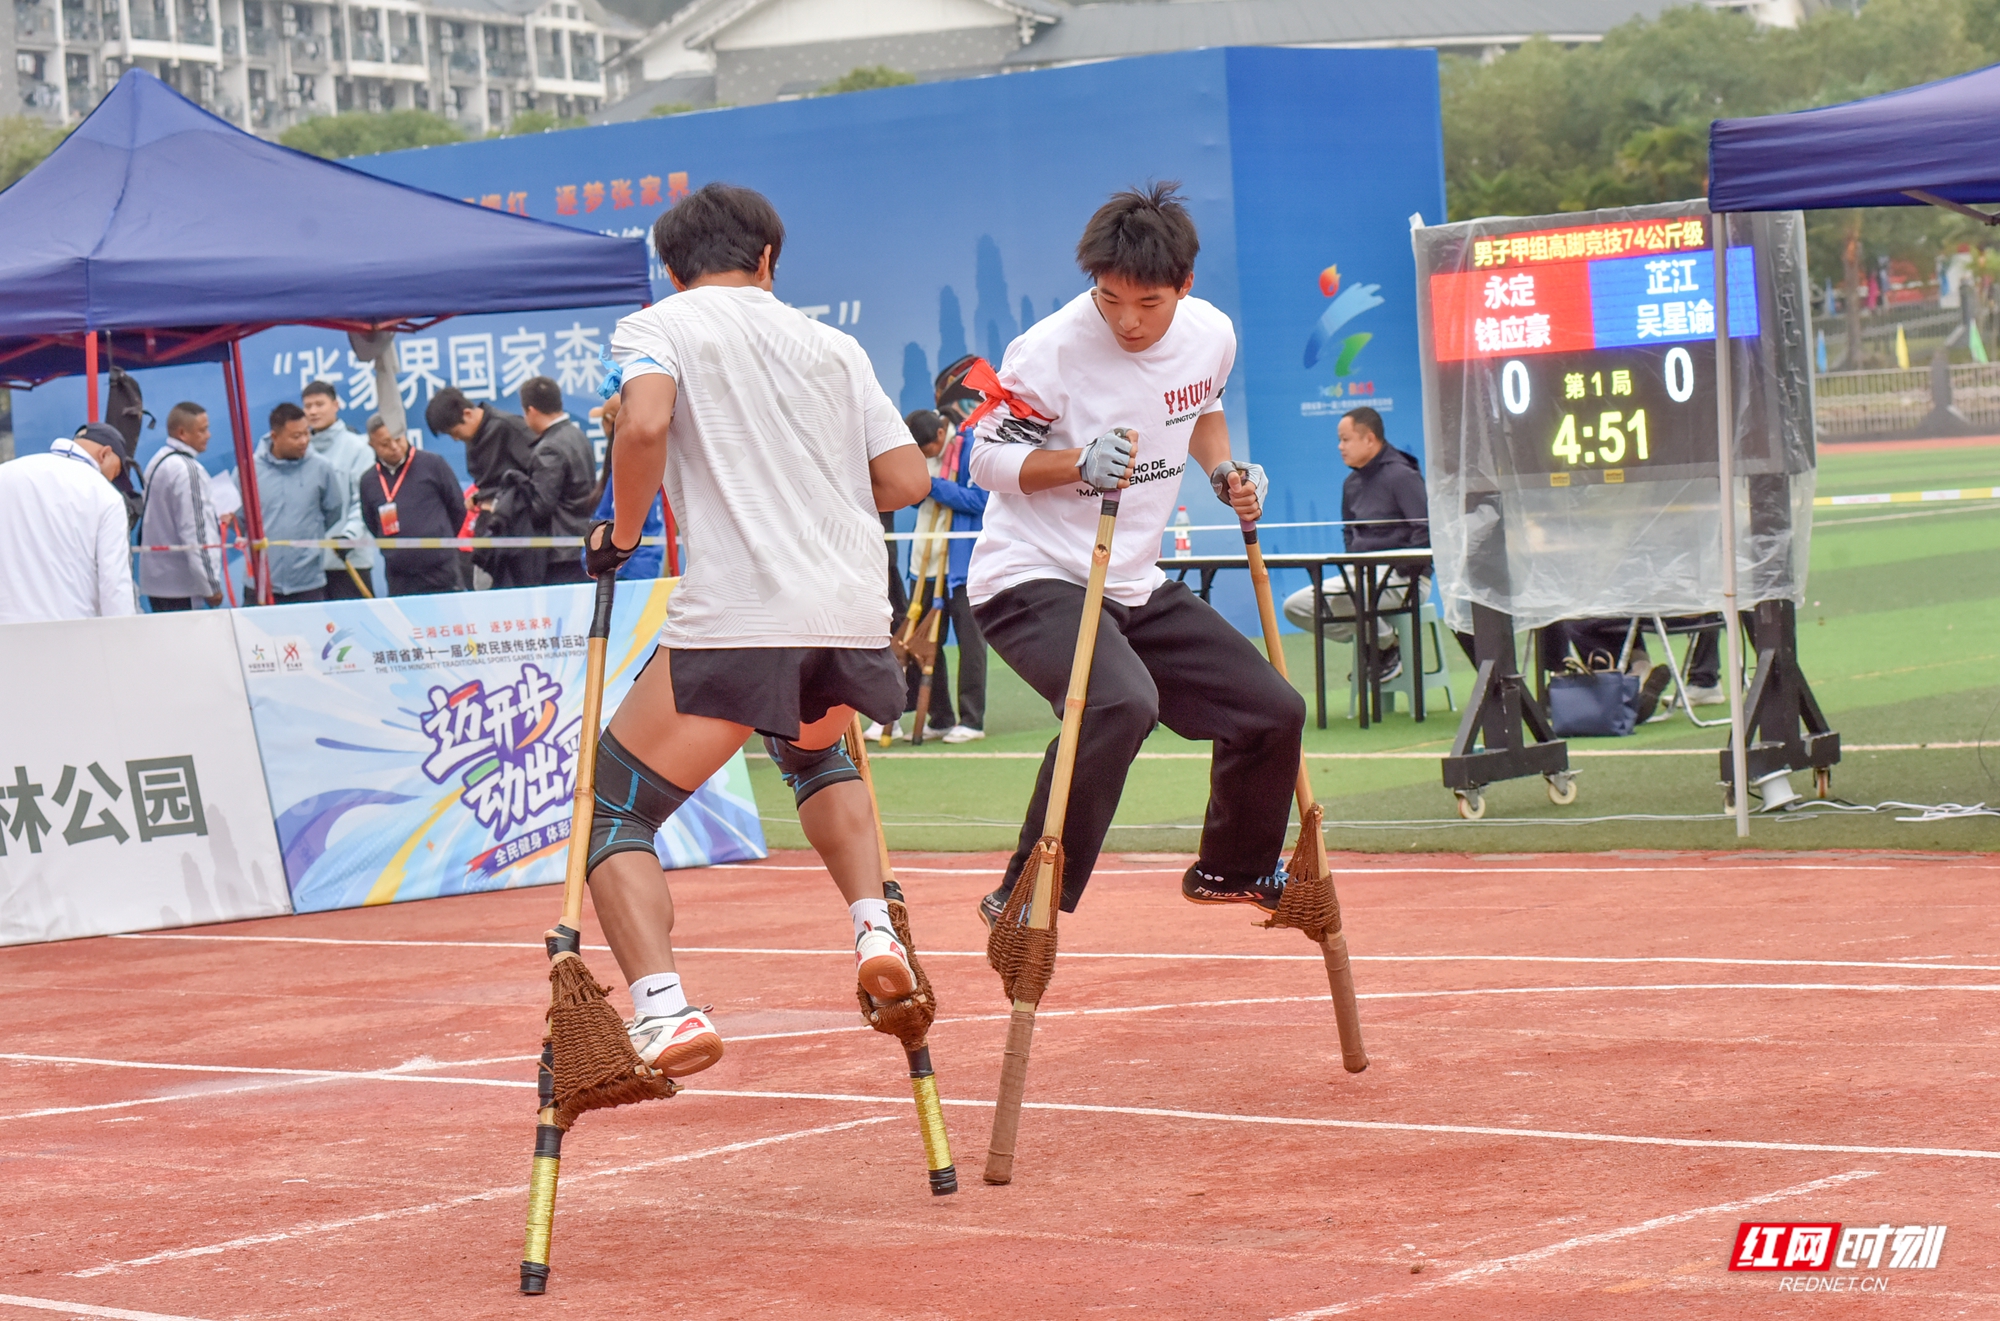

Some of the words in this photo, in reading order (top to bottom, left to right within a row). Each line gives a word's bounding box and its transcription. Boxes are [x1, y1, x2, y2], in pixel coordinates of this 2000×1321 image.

[1474, 221, 1704, 267] 男子甲组高脚竞技74公斤级
[1484, 273, 1535, 309] 永定
[1645, 259, 1699, 295] 芷江
[1474, 313, 1552, 352] 钱应豪
[1636, 298, 1715, 339] 吴星谕
[1502, 360, 1531, 415] 0
[1665, 347, 1694, 402] 0
[1165, 411, 1197, 427] RIVINGTON
[1552, 409, 1649, 464] 4:51
[1151, 458, 1166, 470] DE
[412, 623, 478, 639] 三湘石榴红
[490, 617, 552, 633] 逐梦张家界
[372, 635, 589, 665] 湖南省第十一届少数民族传统体育运动
[390, 665, 407, 673] 11TH
[408, 662, 441, 671] MINORITY
[442, 658, 486, 668] TRADITIONAL
[487, 656, 511, 664] SPORTS
[512, 654, 535, 662] GAMES
[544, 651, 567, 660] HUNAN
[422, 664, 562, 783] 迈开步
[494, 832, 543, 868] 全民健身
